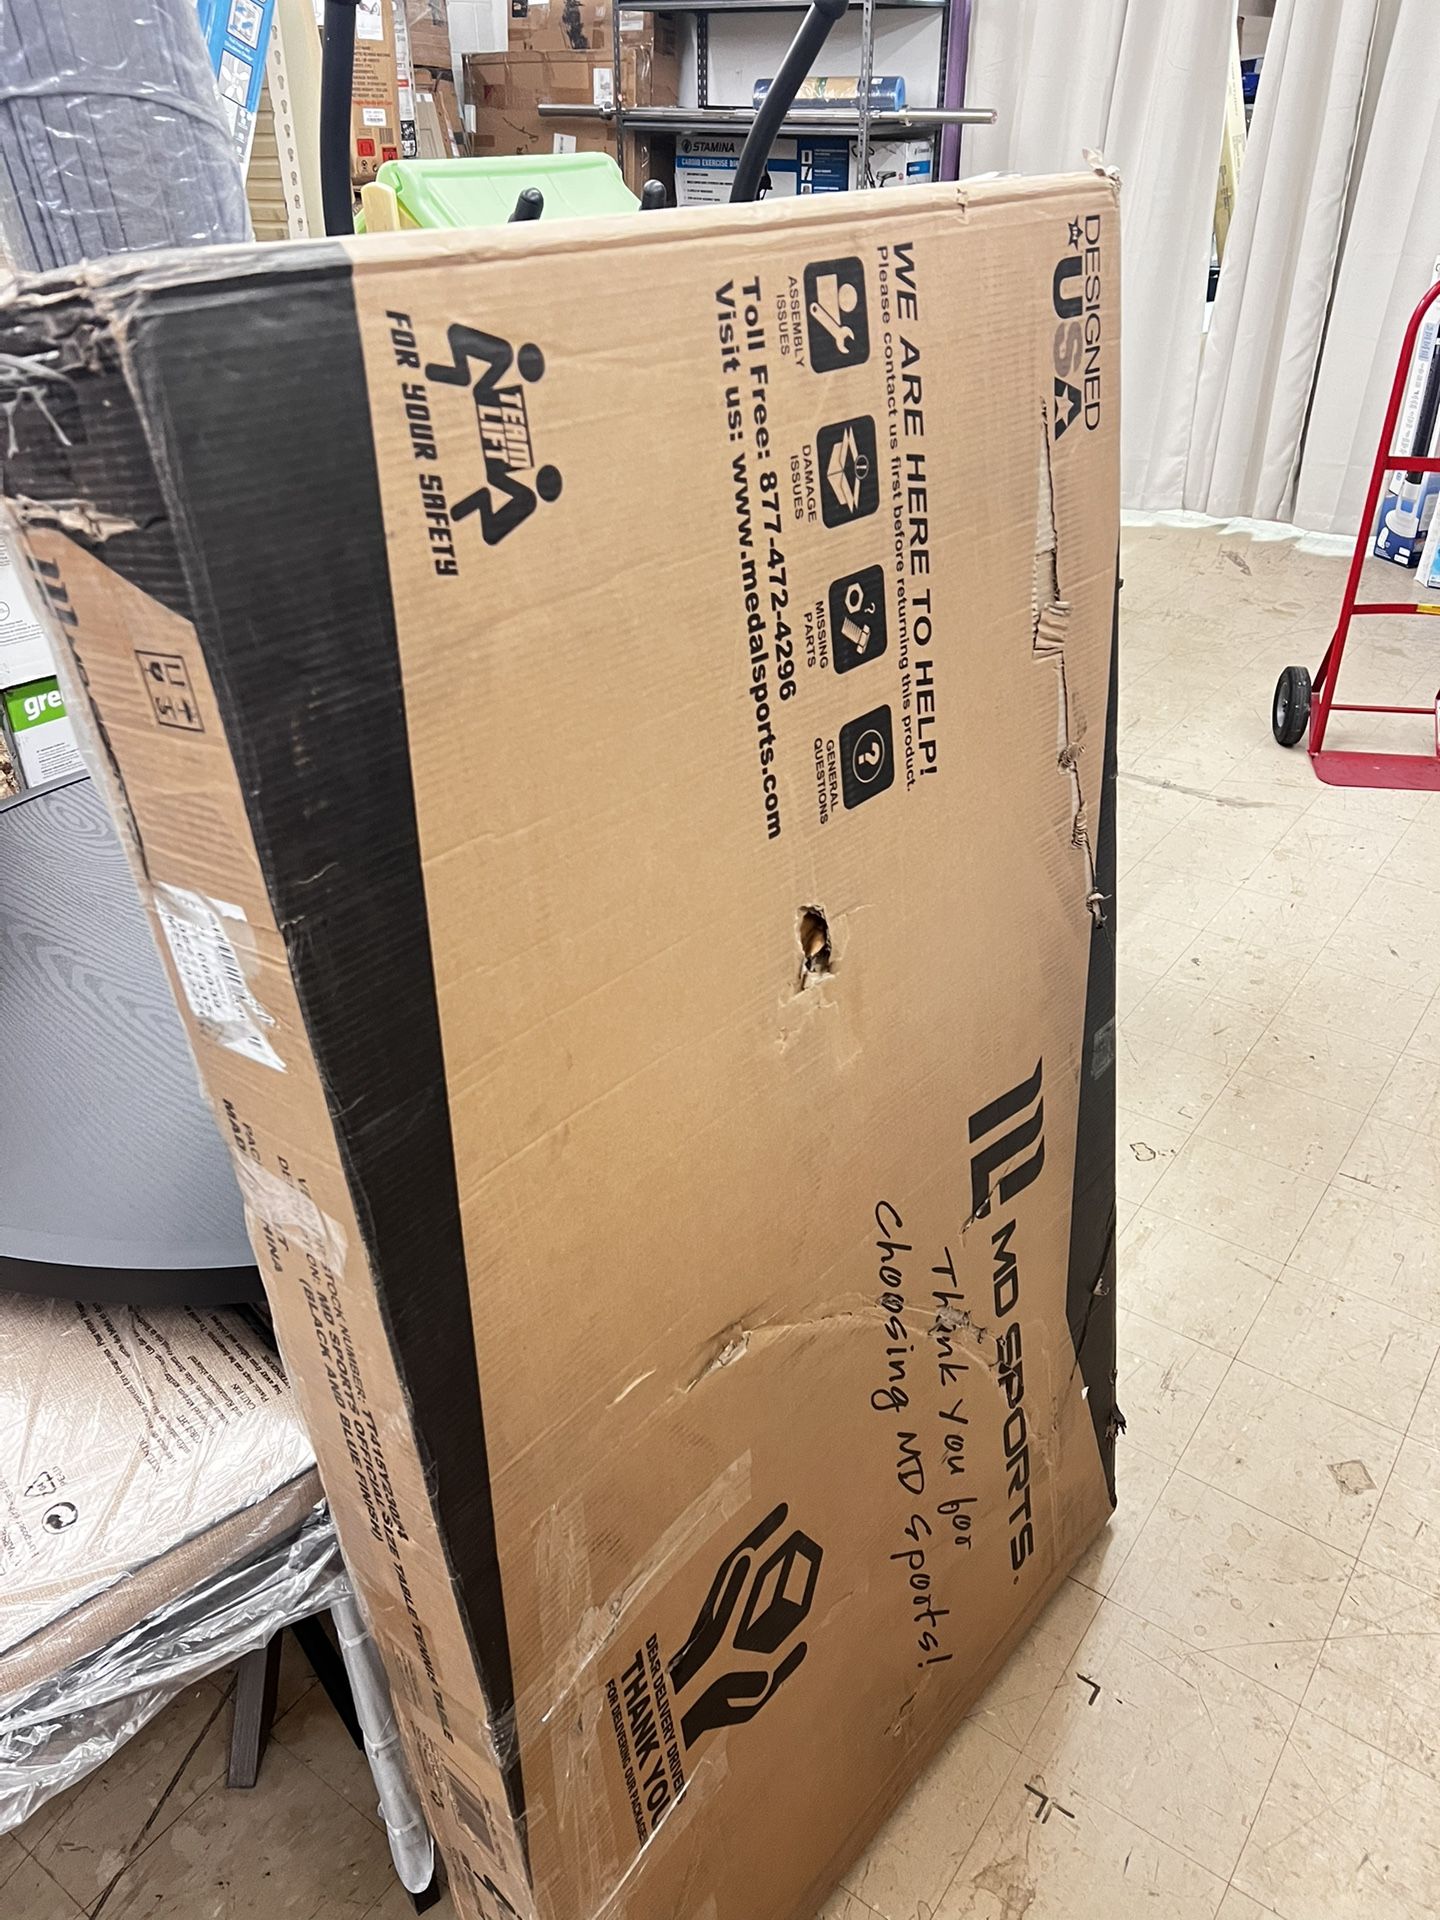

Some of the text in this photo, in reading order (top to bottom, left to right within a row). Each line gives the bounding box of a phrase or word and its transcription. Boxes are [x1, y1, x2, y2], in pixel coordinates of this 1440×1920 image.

[693, 141, 735, 153] STAMINA
[776, 293, 790, 356] ISSUES
[787, 275, 805, 368] ASSEMBLY
[1053, 255, 1083, 441] USA
[1084, 214, 1101, 431] DESIGNED
[385, 310, 459, 577] FOR YOUR SAFETY
[478, 403, 511, 464] LIFT
[498, 391, 531, 468] TEAM
[742, 276, 797, 701] Toll Free: 877-472-4296
[790, 454, 804, 520] ISSUES
[802, 445, 817, 523] DAMAGE
[877, 246, 916, 792] Please contact us first before returning this product.
[893, 242, 938, 776] WE ARE HERE TO HELP!
[715, 280, 782, 840] Visit us: www.medalsports.com
[803, 612, 816, 668] PARTS
[815, 600, 829, 669] MISSING
[814, 737, 828, 825] QUESTIONS
[825, 739, 837, 813] GENERAL
[223, 1098, 251, 1155] MAD
[991, 1218, 1020, 1318] MD
[339, 1323, 368, 1404] NUMBER:
[299, 1278, 333, 1362] (BLACK
[324, 1363, 346, 1409] AND
[340, 1412, 363, 1469] BLUE
[355, 1470, 383, 1541] FINISH)
[316, 1291, 334, 1326] MD
[329, 1330, 360, 1416] SPORTS
[354, 1420, 385, 1507] OFFICIAL
[382, 1511, 400, 1560] SIZE
[394, 1561, 419, 1621] TABLE
[411, 1622, 438, 1687] TENNIS
[897, 1431, 925, 1495] MD
[605, 1678, 619, 1705] FOR
[646, 1632, 662, 1677] DEAR
[611, 1703, 631, 1769] DELIVERING
[621, 1649, 660, 1771] THANK
[653, 1675, 676, 1744] DELIVERY
[624, 1766, 636, 1795] OUR
